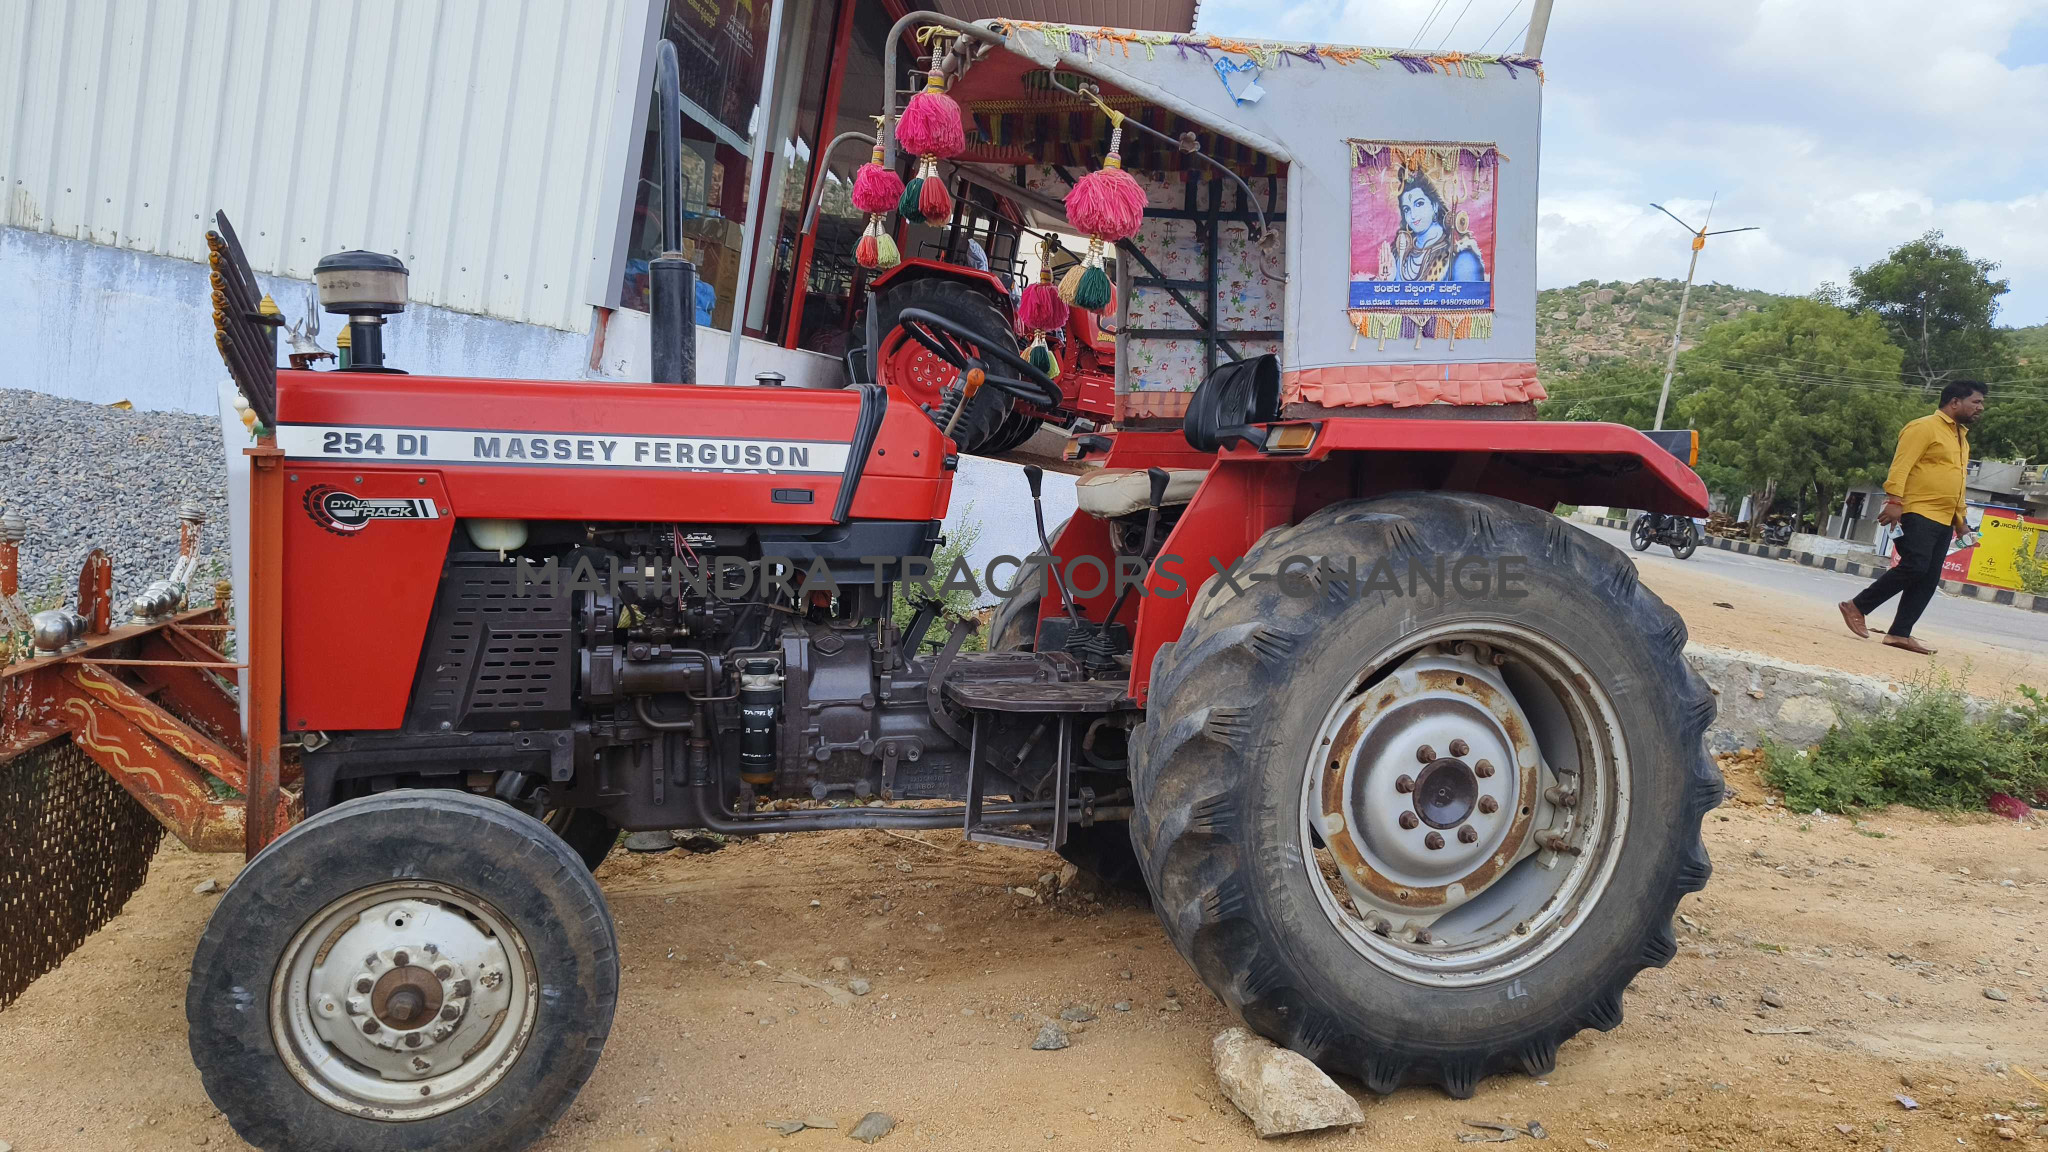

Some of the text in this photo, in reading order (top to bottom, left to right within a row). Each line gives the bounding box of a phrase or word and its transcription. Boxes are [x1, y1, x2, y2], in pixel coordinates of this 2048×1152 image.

[323, 432, 810, 467] 254 DI MASSEY FERGUSON
[330, 500, 370, 508] DYNA
[353, 506, 413, 517] TRACK
